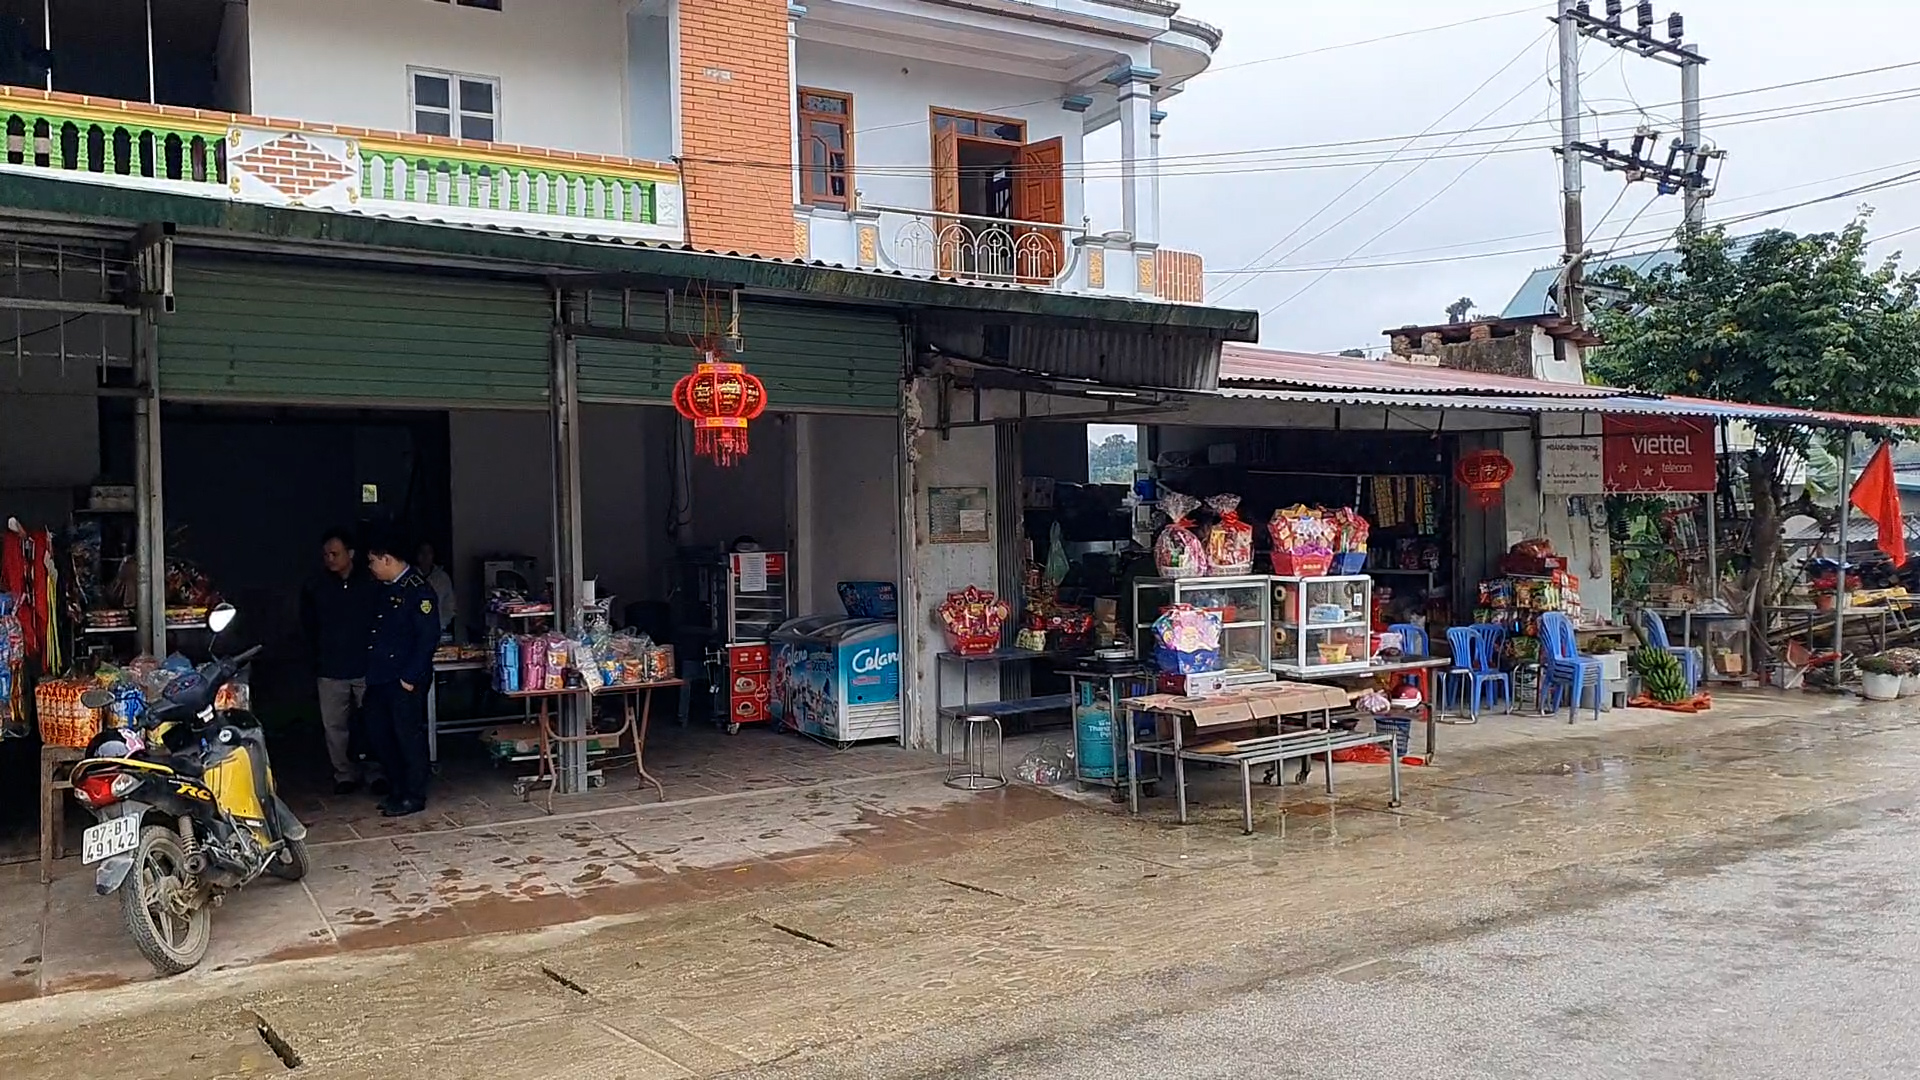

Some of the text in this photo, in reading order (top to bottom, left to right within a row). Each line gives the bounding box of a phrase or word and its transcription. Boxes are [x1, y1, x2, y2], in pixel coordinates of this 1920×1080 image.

[1631, 434, 1692, 455] viettel
[1661, 461, 1692, 473] telecom
[92, 818, 130, 842] 97-B1
[87, 832, 135, 860] 491.42
